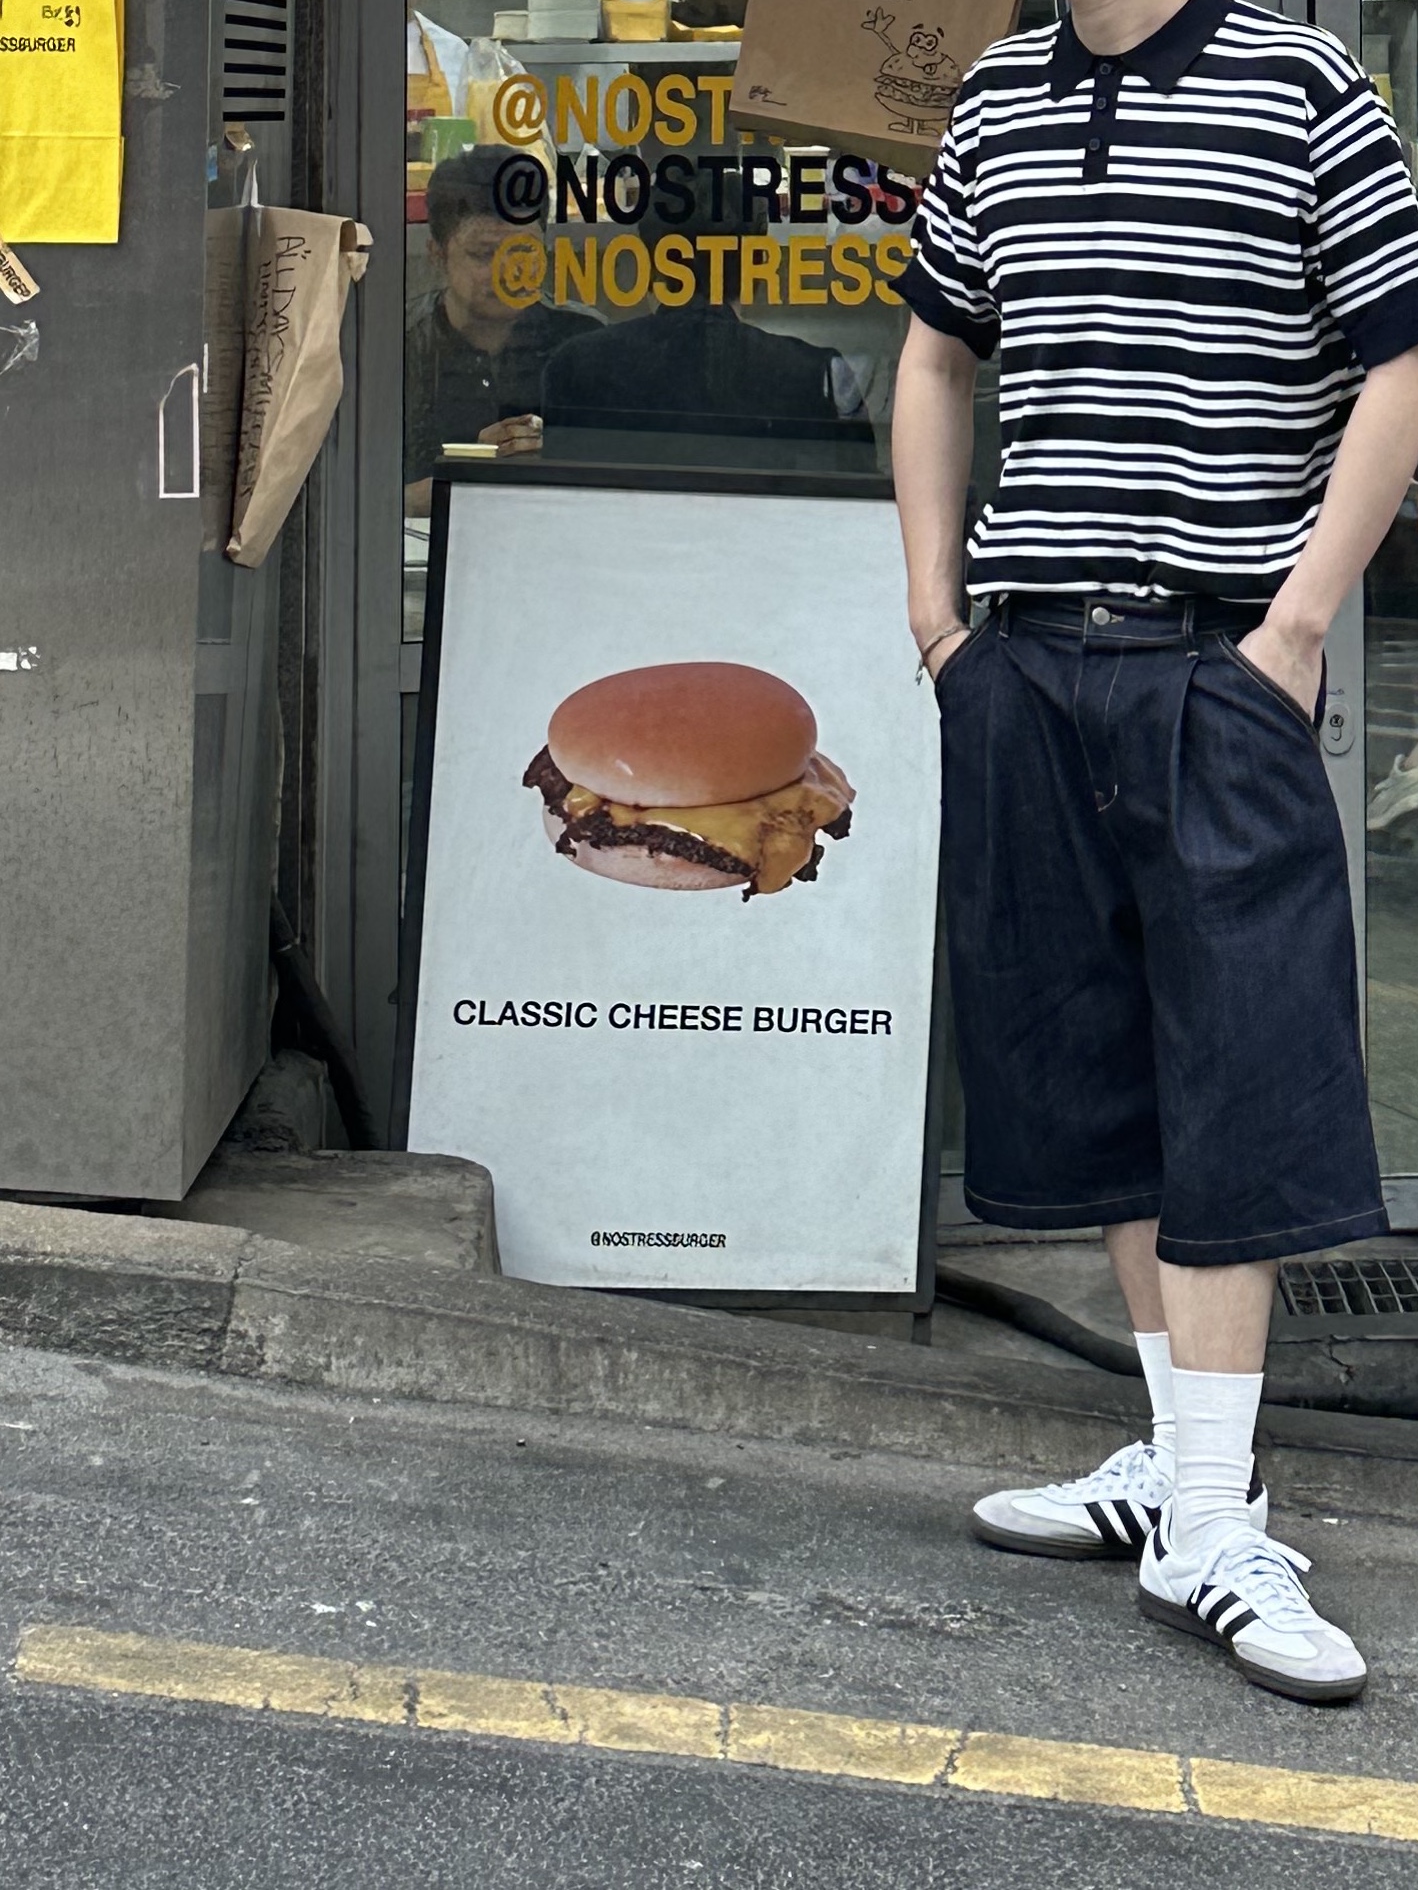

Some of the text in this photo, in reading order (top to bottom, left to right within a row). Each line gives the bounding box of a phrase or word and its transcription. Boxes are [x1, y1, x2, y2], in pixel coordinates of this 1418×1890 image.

[452, 998, 894, 1038] CLASSIC CHEESE BURGER
